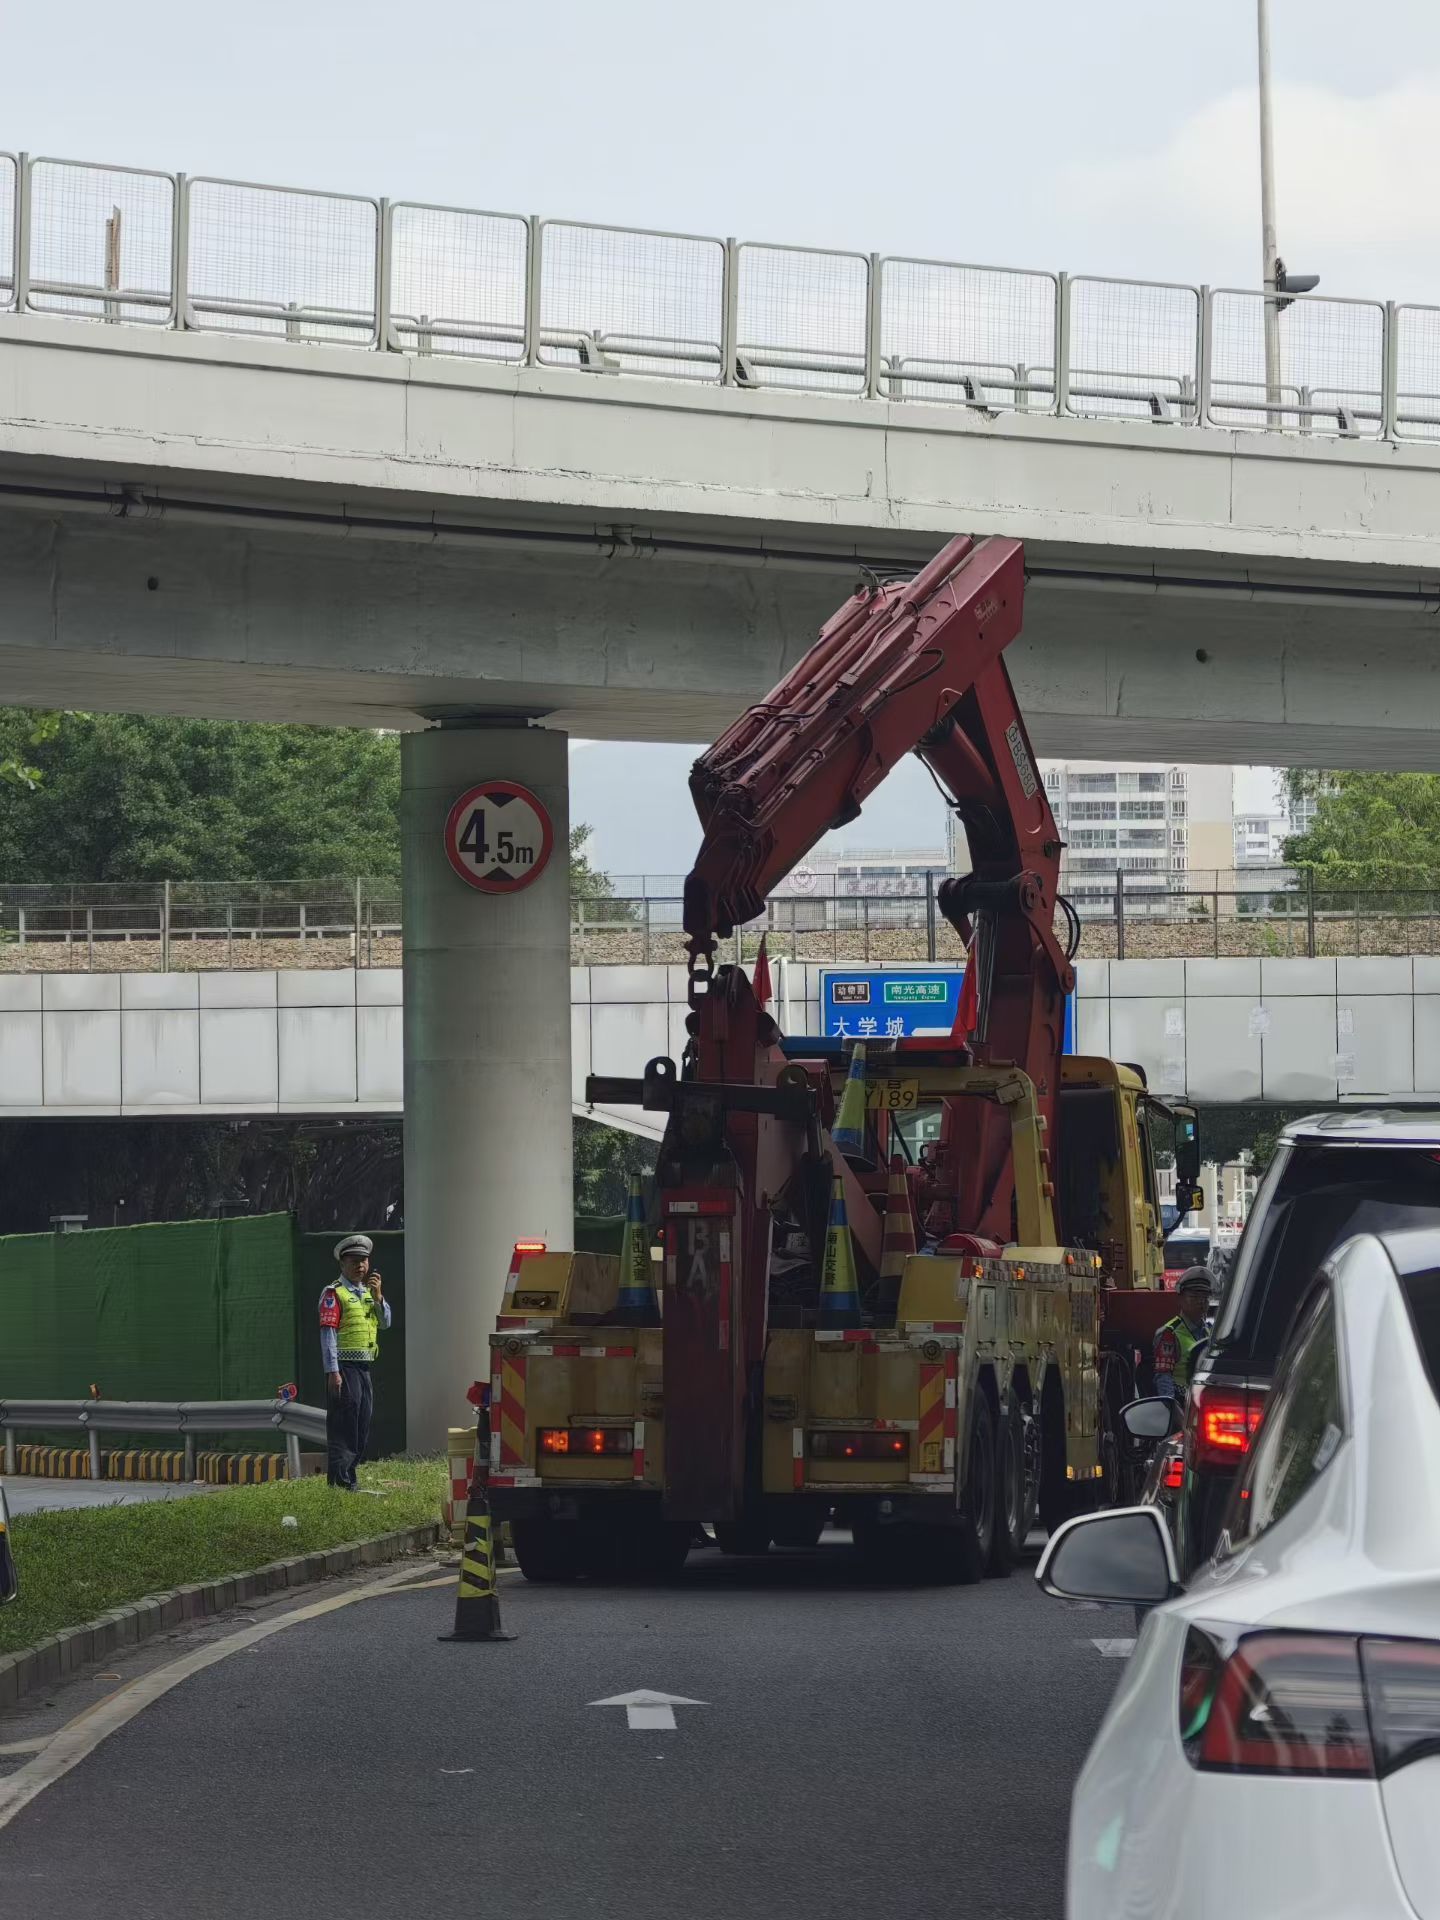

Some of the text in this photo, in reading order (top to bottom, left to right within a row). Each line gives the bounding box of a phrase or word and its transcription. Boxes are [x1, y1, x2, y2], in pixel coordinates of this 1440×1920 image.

[458, 808, 534, 864] 4.5m
[837, 984, 865, 996] 动物园
[891, 984, 940, 995] 南光高速
[832, 1016, 905, 1037] 大学城
[864, 1090, 914, 1107] Y189
